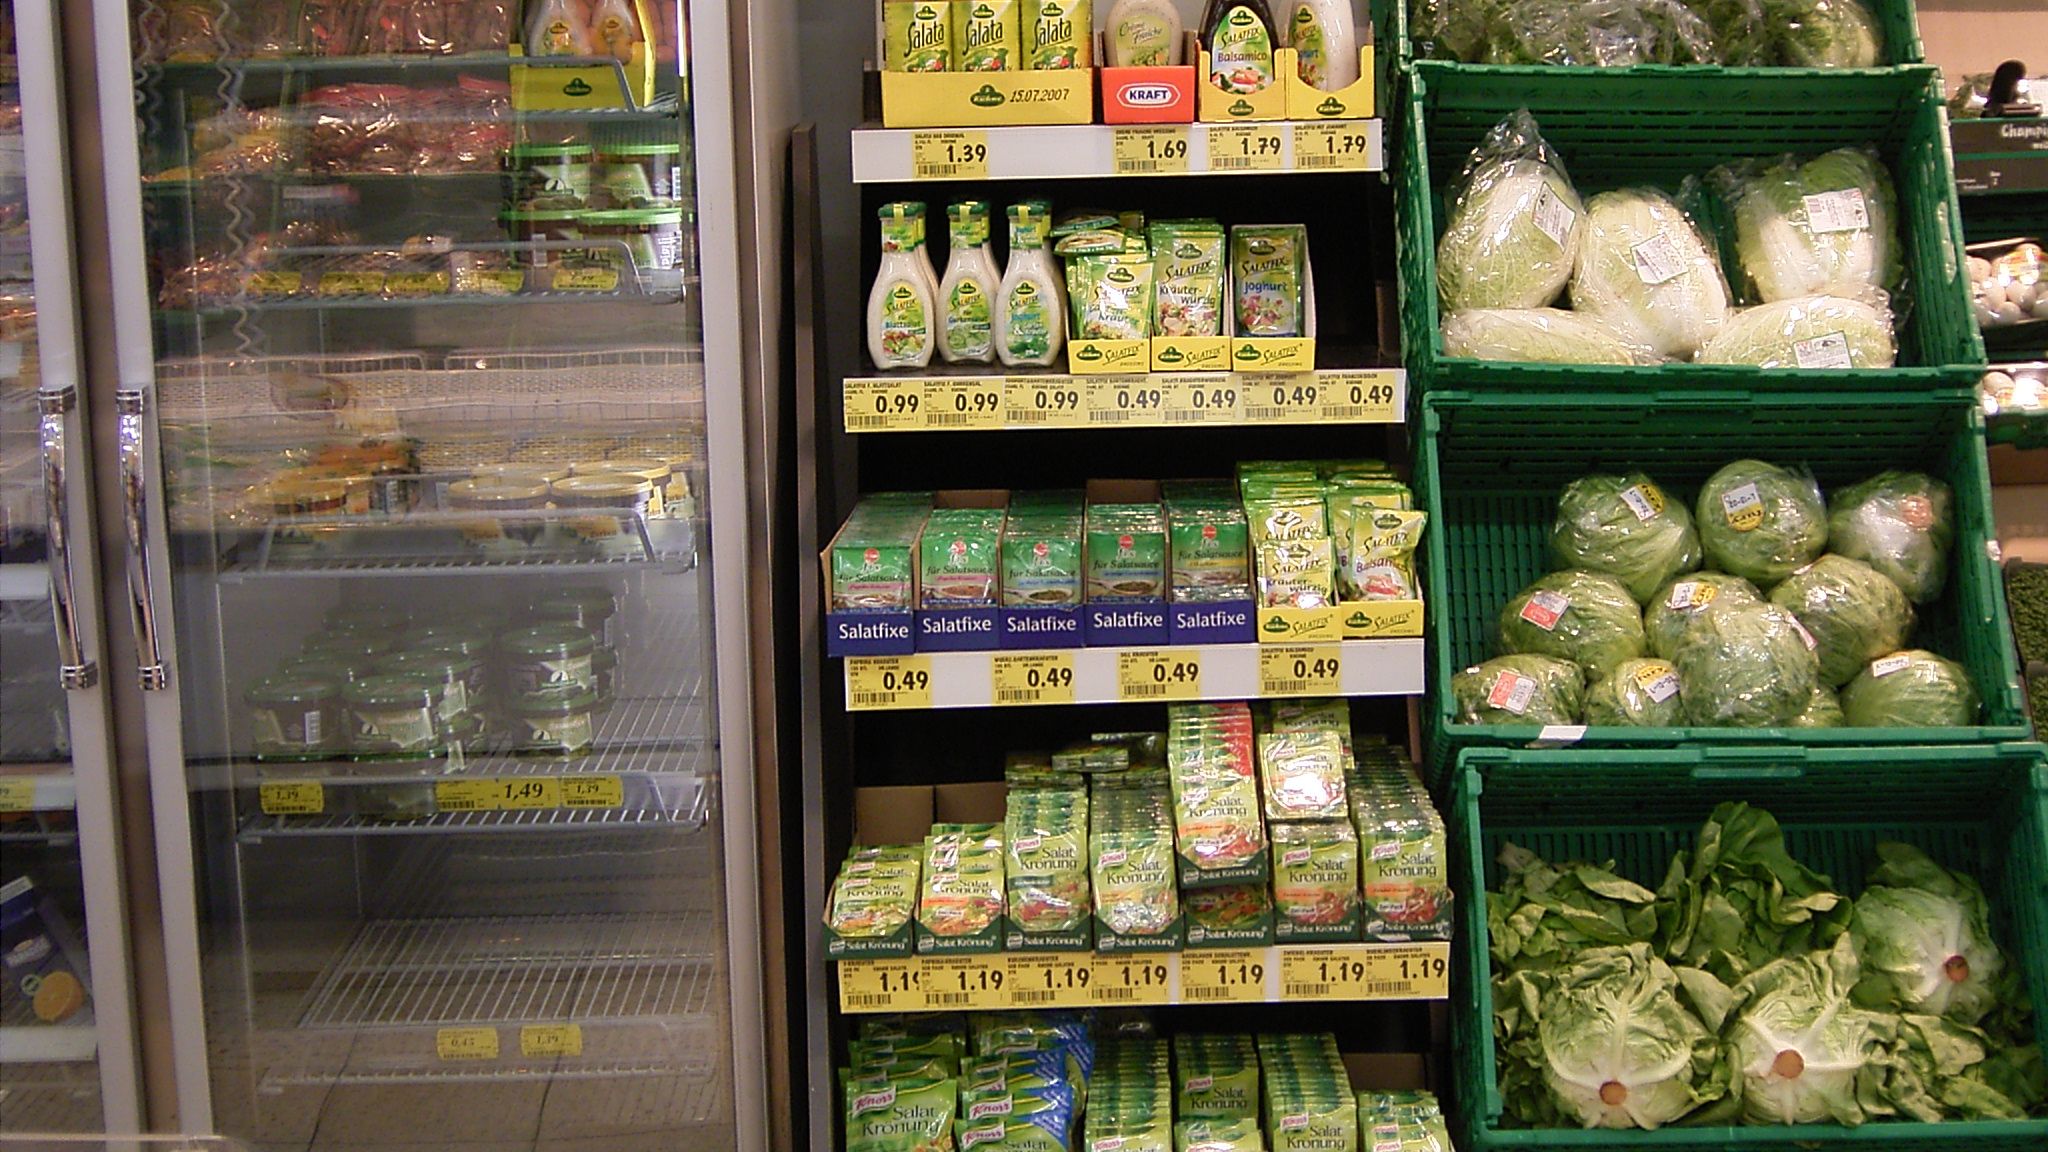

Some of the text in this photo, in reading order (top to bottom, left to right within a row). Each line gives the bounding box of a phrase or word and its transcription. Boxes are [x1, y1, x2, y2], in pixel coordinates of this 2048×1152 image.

[904, 22, 944, 57] Salata
[962, 19, 1003, 55] Salata
[1031, 18, 1071, 54] Salata
[1218, 50, 1267, 62] Balsamico
[1010, 88, 1070, 103] 15.07.2007
[1129, 90, 1169, 101] KRAFT
[946, 144, 986, 162] 1.39
[1147, 140, 1187, 158] 1.69
[1241, 137, 1281, 155] 1.79
[1326, 135, 1366, 154] 1.79
[1165, 258, 1212, 283] SALATFIX
[1241, 256, 1290, 279] SALATFIX
[1244, 281, 1288, 294] Joghurt
[1013, 324, 1024, 335] &
[1103, 345, 1139, 365] SALATFIX
[1184, 347, 1222, 366] SALATFIX
[1261, 345, 1299, 365] SALATFIX
[875, 394, 919, 413] 0.99
[955, 393, 999, 412] 0.99
[1035, 391, 1079, 410] 0.99
[1117, 389, 1161, 409] 0.49
[1192, 389, 1236, 408] 0.49
[1273, 386, 1317, 405] 0.49
[1350, 385, 1393, 404] 0.49
[923, 617, 993, 634] Salatfixe
[1007, 616, 1077, 633] Salatfixe
[1093, 612, 1164, 628] Salatfixe
[1177, 611, 1247, 628] Salatfixe
[1291, 617, 1329, 637] SALATFIX
[1372, 612, 1411, 632] SALATFIX
[839, 622, 909, 639] Salatfixe
[1027, 668, 1073, 687] 0.49
[1154, 662, 1199, 682] 0.49
[1294, 659, 1339, 678] 0.49
[883, 671, 928, 690] 0.49
[504, 783, 543, 800] 1,49
[1211, 796, 1243, 806] Salat
[1042, 847, 1074, 859] Salat
[1402, 853, 1434, 864] Salat
[1128, 862, 1160, 872] Salat
[1312, 860, 1344, 871] Salat
[1024, 937, 1043, 945] Salat
[1117, 938, 1136, 946] Salat
[1044, 967, 1089, 988] 1.19
[1122, 965, 1167, 986] 1.19
[1218, 964, 1263, 985] 1.19
[1319, 962, 1364, 982] 1.19
[1400, 958, 1445, 979] 1.19
[958, 970, 1003, 991] 1.19
[855, 1093, 892, 1109] Knorr
[1214, 1088, 1245, 1098] Salat
[893, 1105, 935, 1120] Salat
[972, 1103, 1009, 1117] Knorr
[965, 1130, 1002, 1145] Knorr
[1310, 1127, 1341, 1137] Salat
